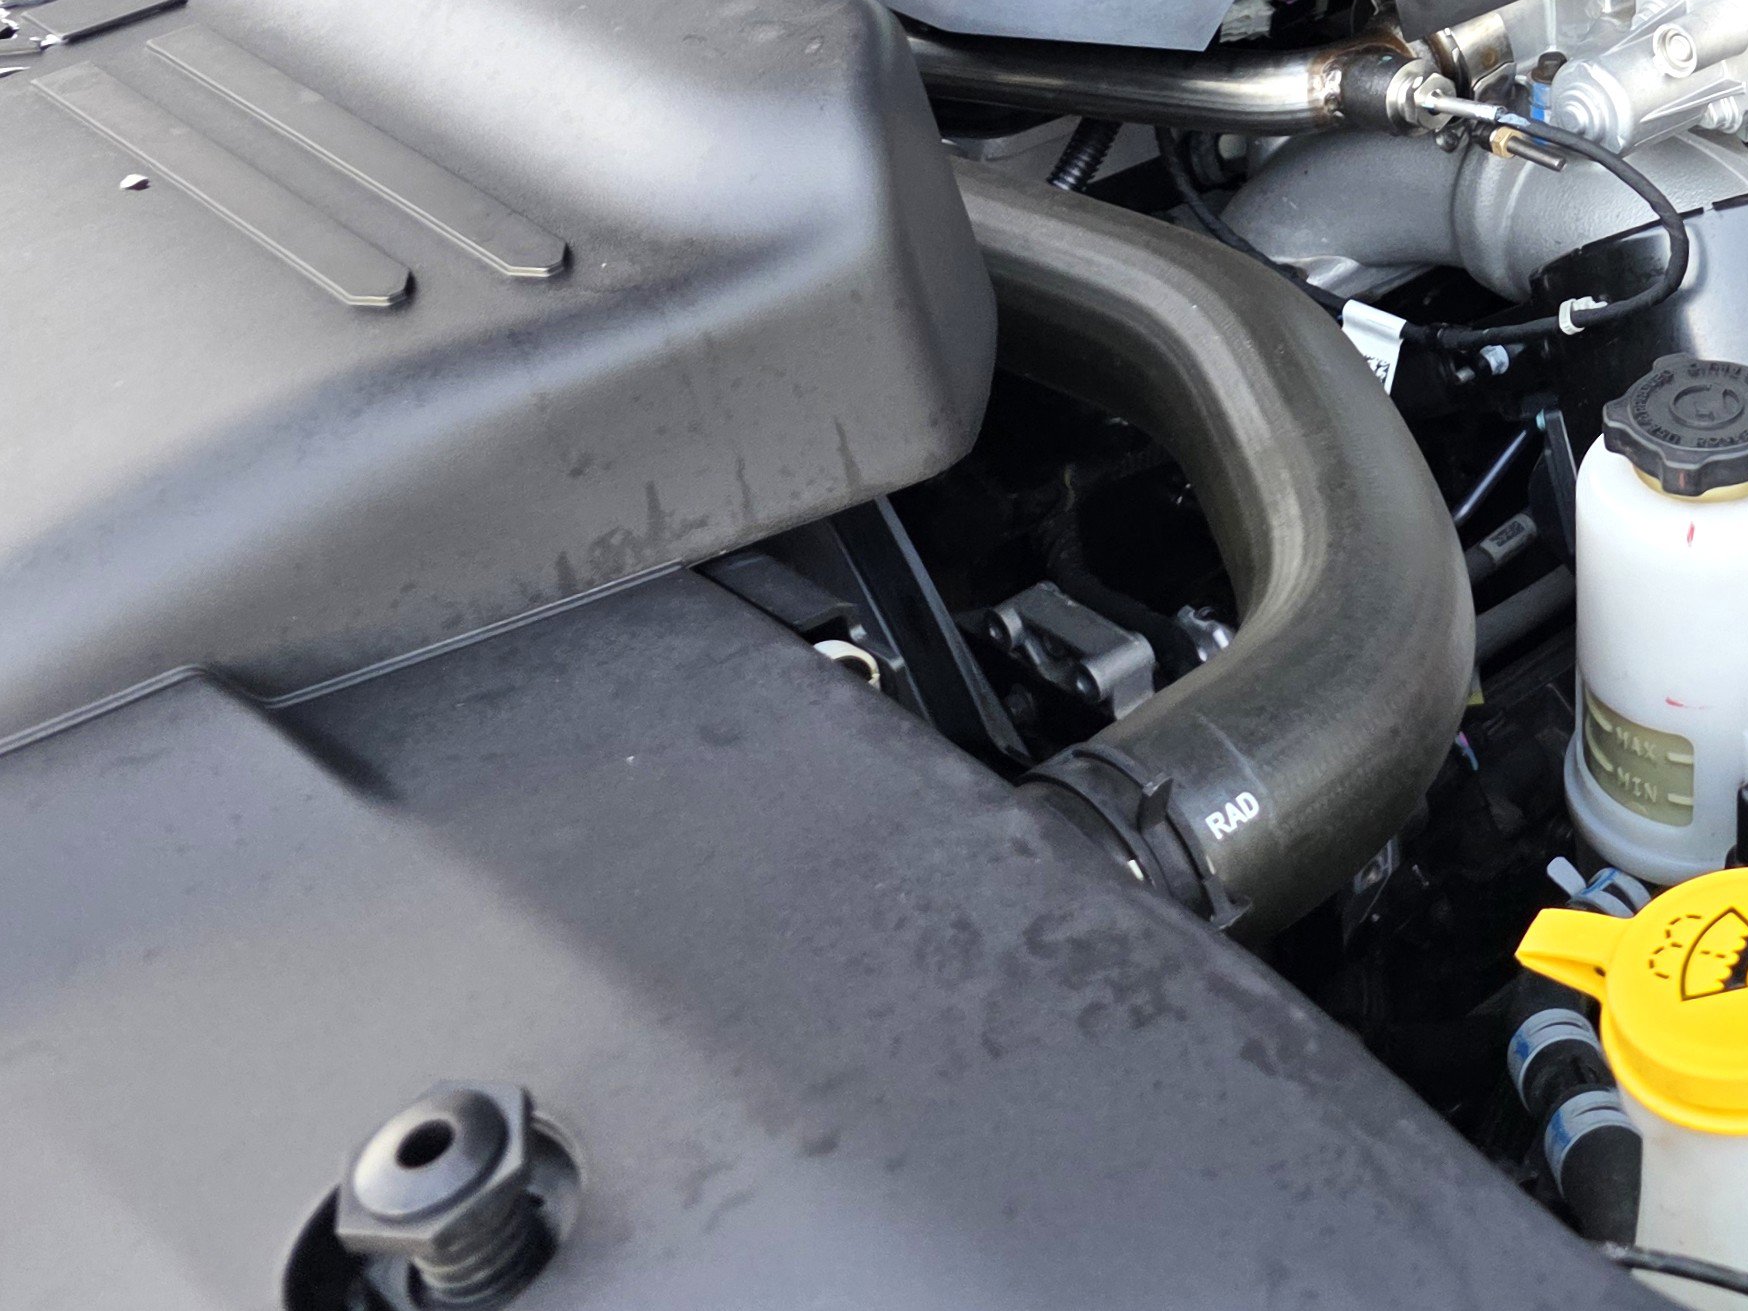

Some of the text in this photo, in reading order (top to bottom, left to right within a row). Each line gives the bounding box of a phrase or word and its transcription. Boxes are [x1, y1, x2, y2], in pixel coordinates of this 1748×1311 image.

[1615, 726, 1657, 760] MAX
[1617, 766, 1657, 803] MIN
[1204, 791, 1260, 840] RAD
